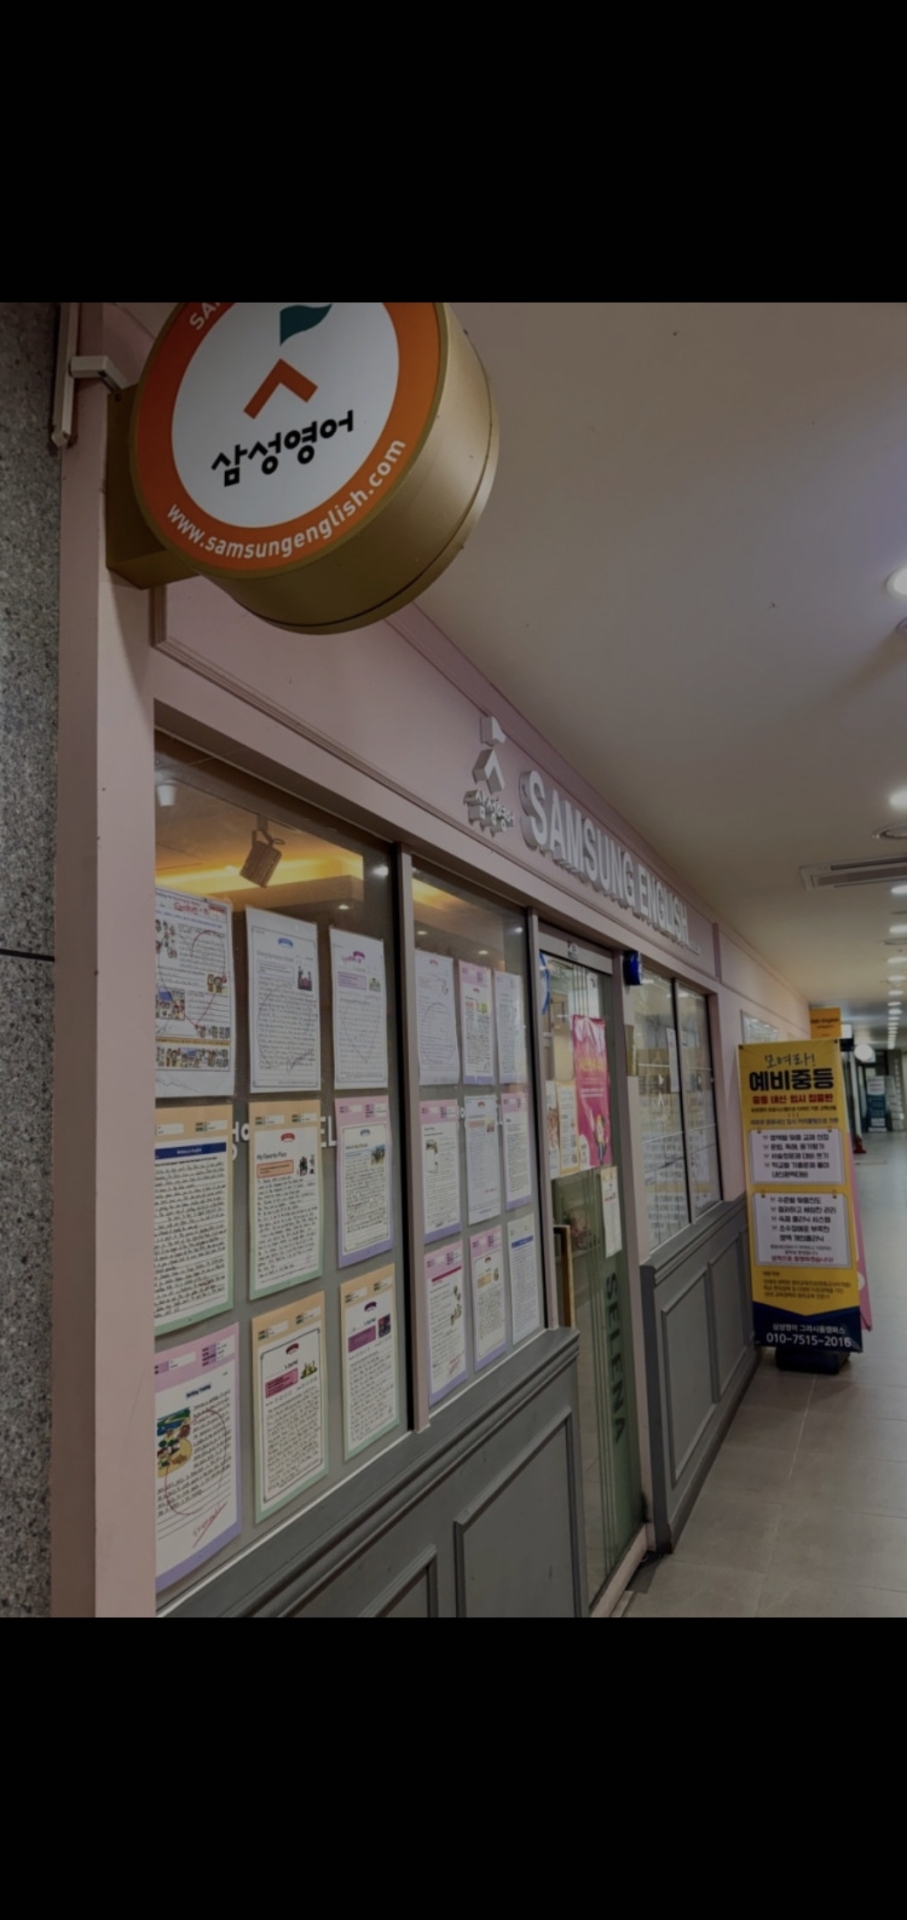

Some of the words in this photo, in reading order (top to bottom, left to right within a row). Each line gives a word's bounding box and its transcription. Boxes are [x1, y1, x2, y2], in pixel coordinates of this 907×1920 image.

[212, 410, 355, 487] 삼성영어
[166, 440, 406, 559] www.samsungenglish.com
[520, 770, 635, 909] SAMSUNG
[632, 864, 691, 949] ENGLISH
[749, 1068, 834, 1091] 예비중등
[765, 1053, 816, 1068] 모여라!
[606, 1271, 627, 1444] SELENA
[766, 1332, 852, 1347] 010-7515-2016
